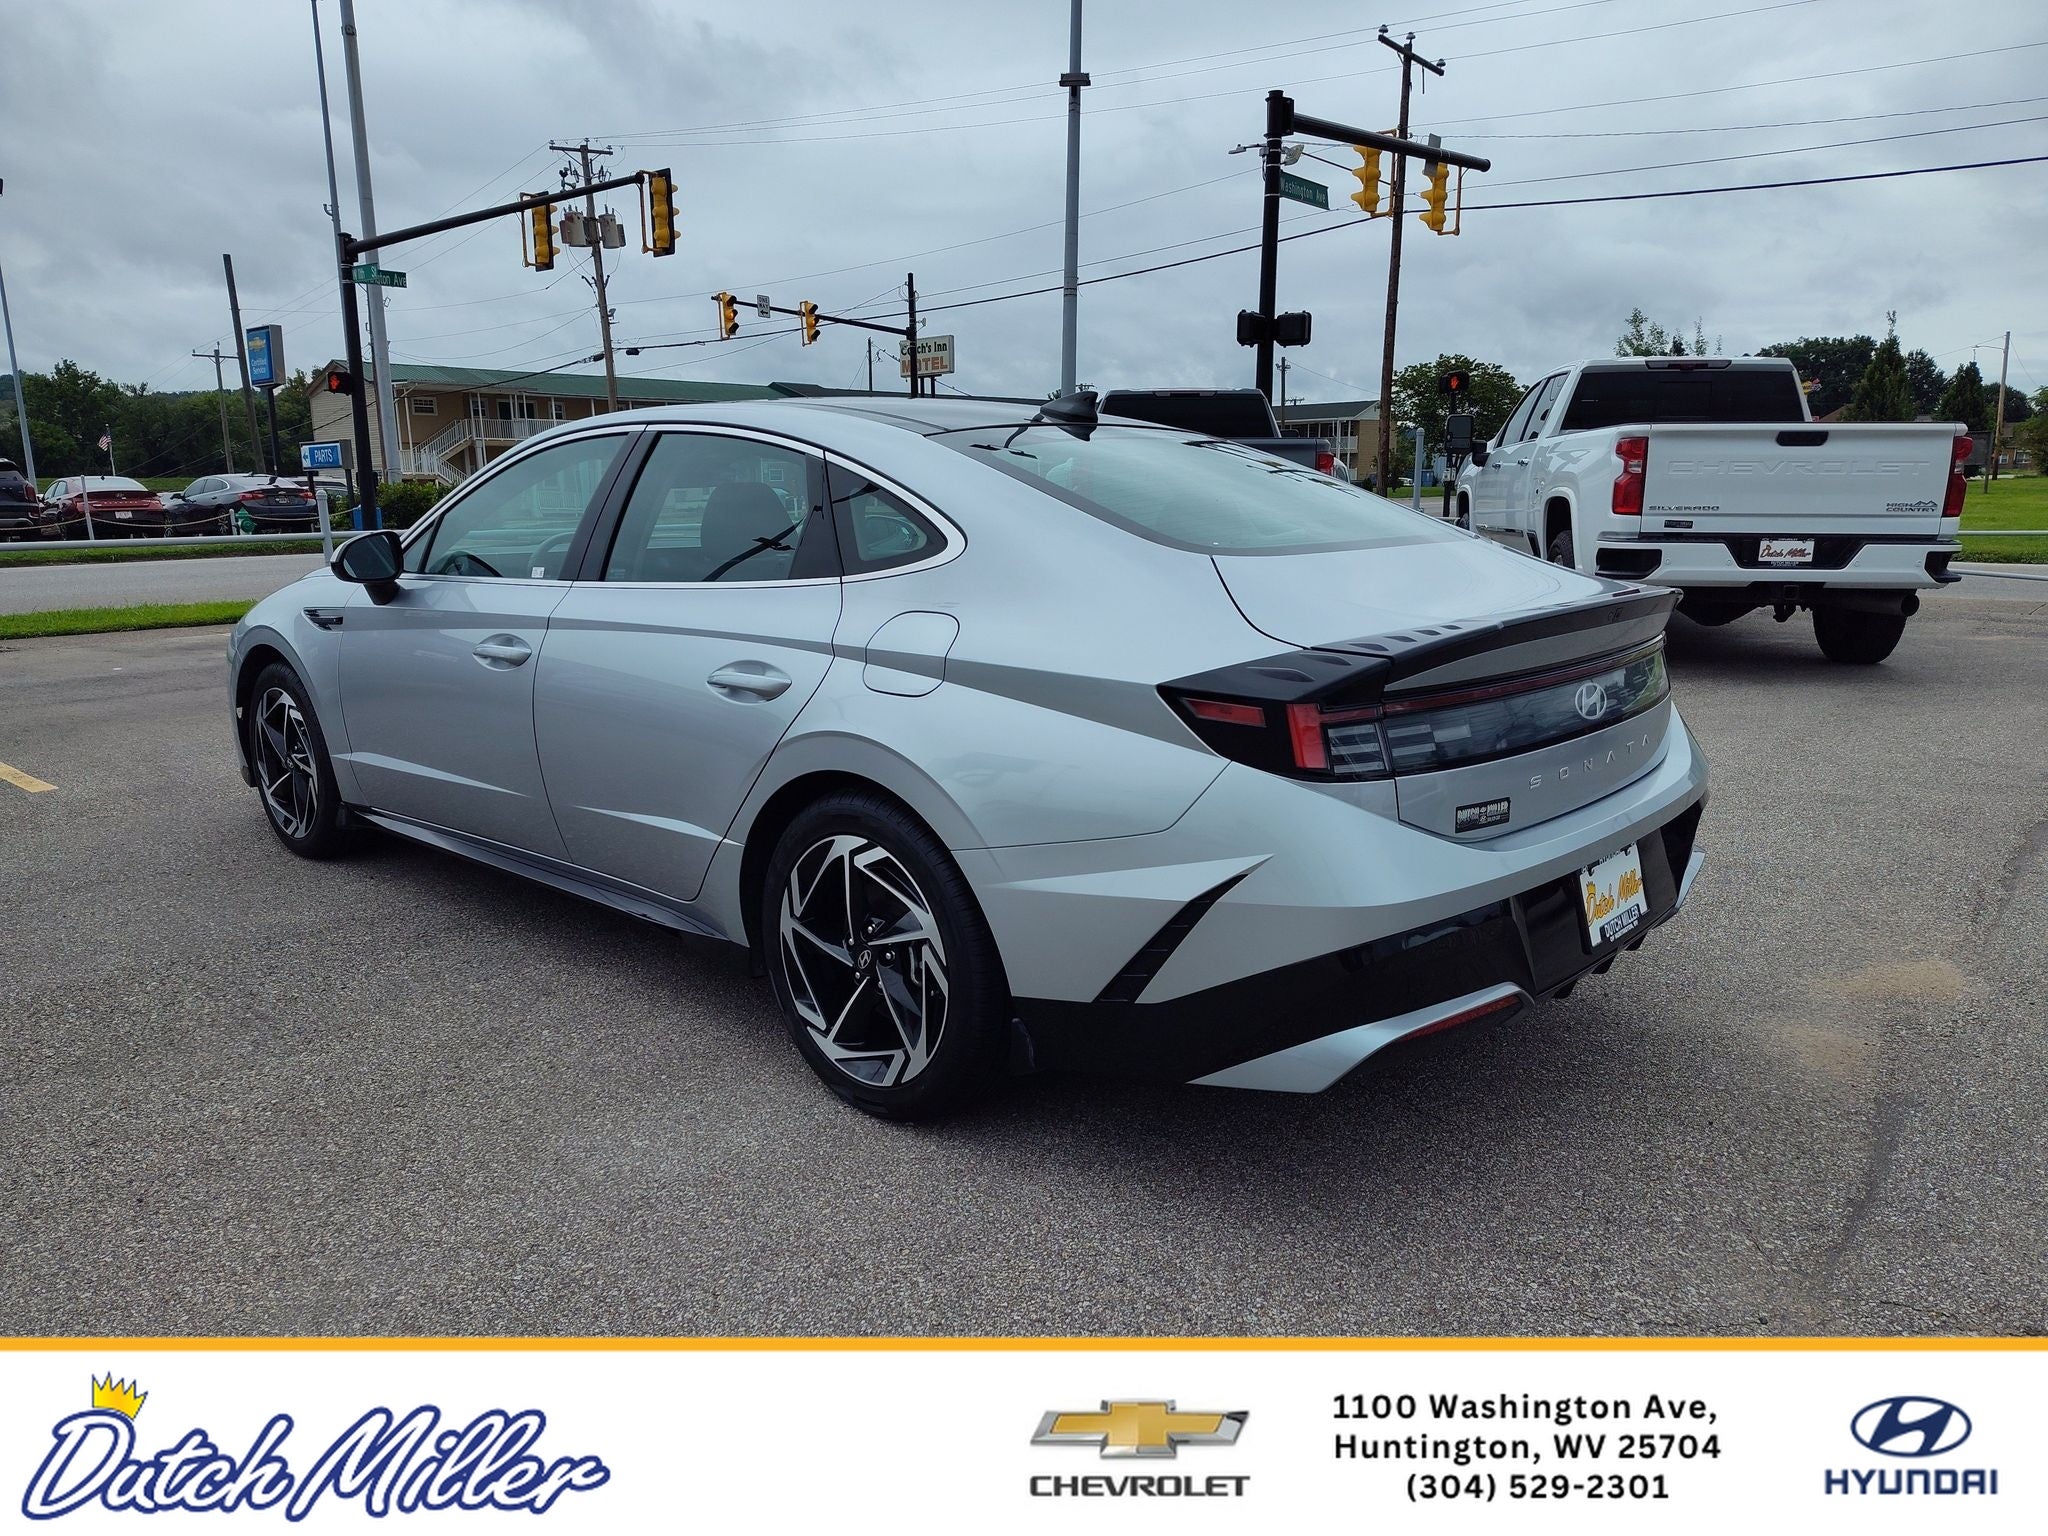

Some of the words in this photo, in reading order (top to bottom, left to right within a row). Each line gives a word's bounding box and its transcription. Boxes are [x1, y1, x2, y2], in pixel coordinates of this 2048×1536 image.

[1280, 178, 1313, 200] Washington
[1315, 189, 1326, 204] Ave
[393, 273, 407, 287] Ave
[901, 342, 932, 355] Coch's
[934, 341, 948, 352] Inn
[314, 449, 333, 463] PARTS
[1668, 460, 1930, 475] CHEVROLET
[1529, 734, 1649, 790] SONATA
[1586, 882, 1615, 928] Dutch
[1617, 868, 1643, 909] Miller
[1604, 916, 1622, 938] DUTCH
[1621, 905, 1641, 929] MILLER
